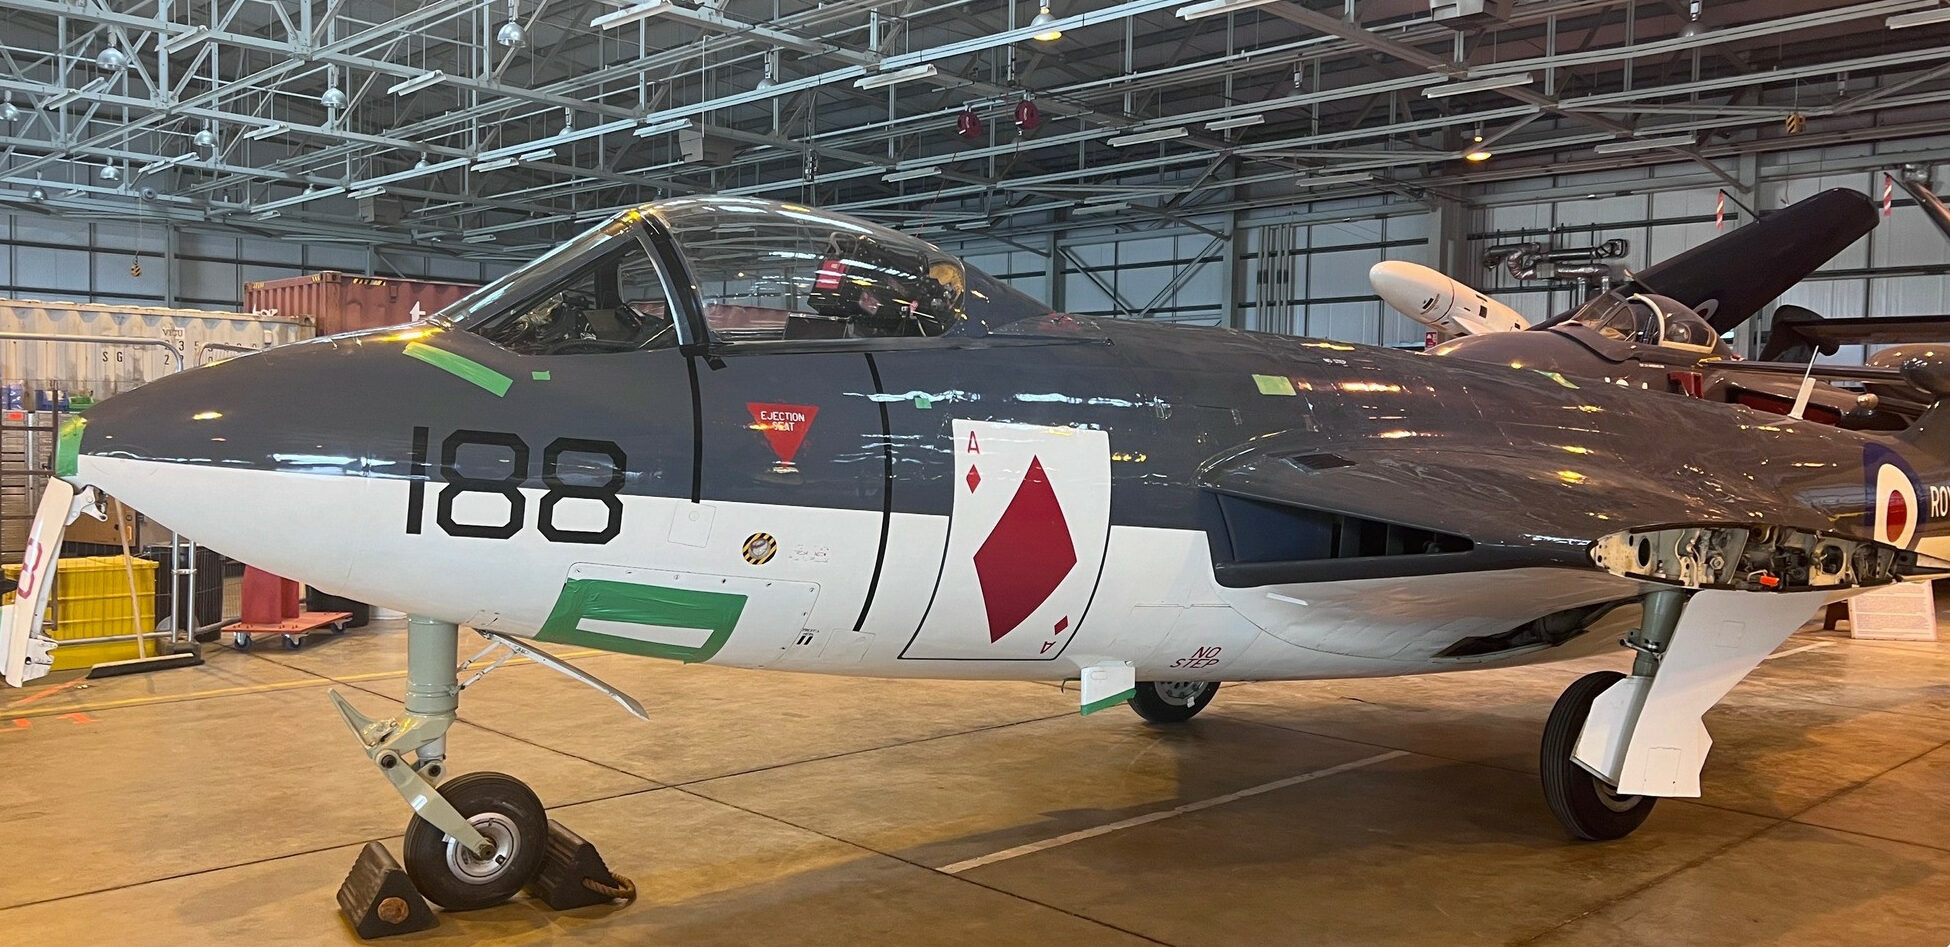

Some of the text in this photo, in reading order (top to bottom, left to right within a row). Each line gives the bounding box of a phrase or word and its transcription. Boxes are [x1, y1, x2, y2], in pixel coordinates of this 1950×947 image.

[760, 410, 806, 422] EJECTION
[772, 421, 795, 432] SEAT
[967, 430, 980, 454] A
[405, 426, 628, 545] 188
[1040, 640, 1057, 654] A
[1191, 646, 1222, 659] NO
[1169, 658, 1220, 669] STEP
